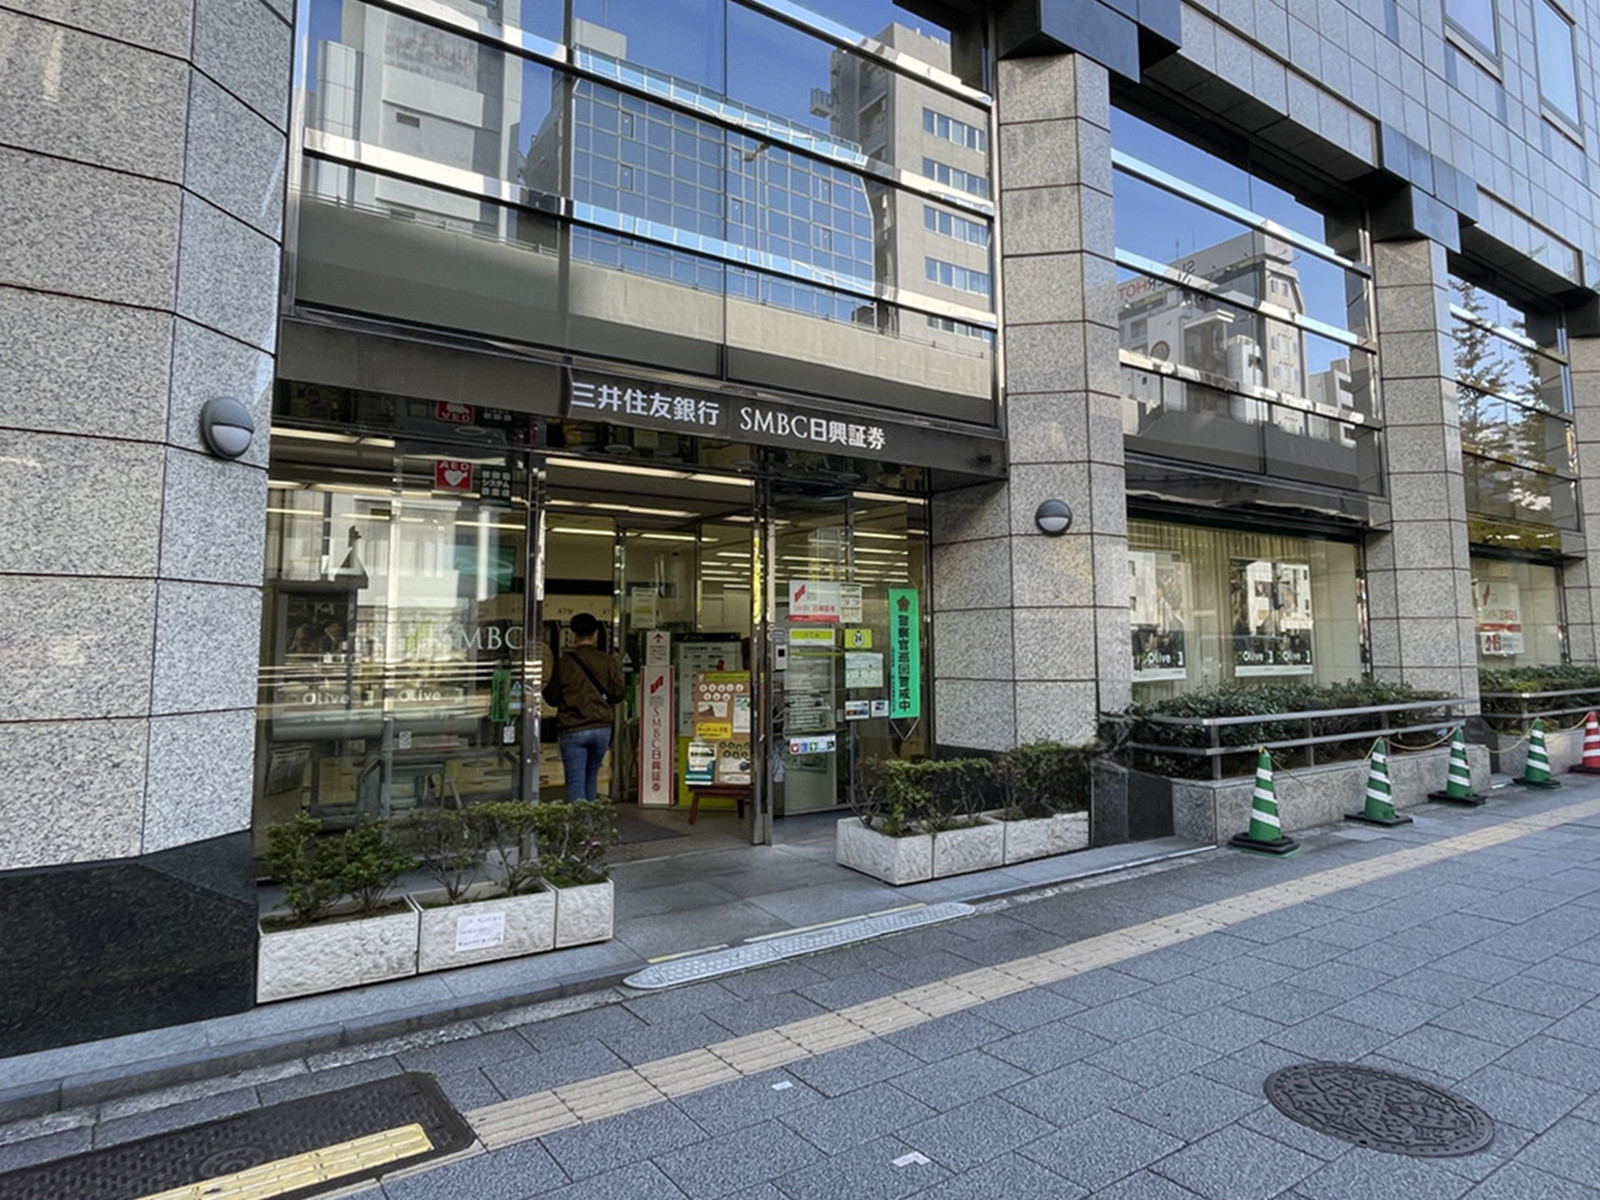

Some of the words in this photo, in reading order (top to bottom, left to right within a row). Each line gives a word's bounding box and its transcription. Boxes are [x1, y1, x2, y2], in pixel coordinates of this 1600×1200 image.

[571, 381, 720, 426] 三井住友銀行
[739, 406, 886, 450] SMBC日興証券
[446, 625, 524, 650] MBC
